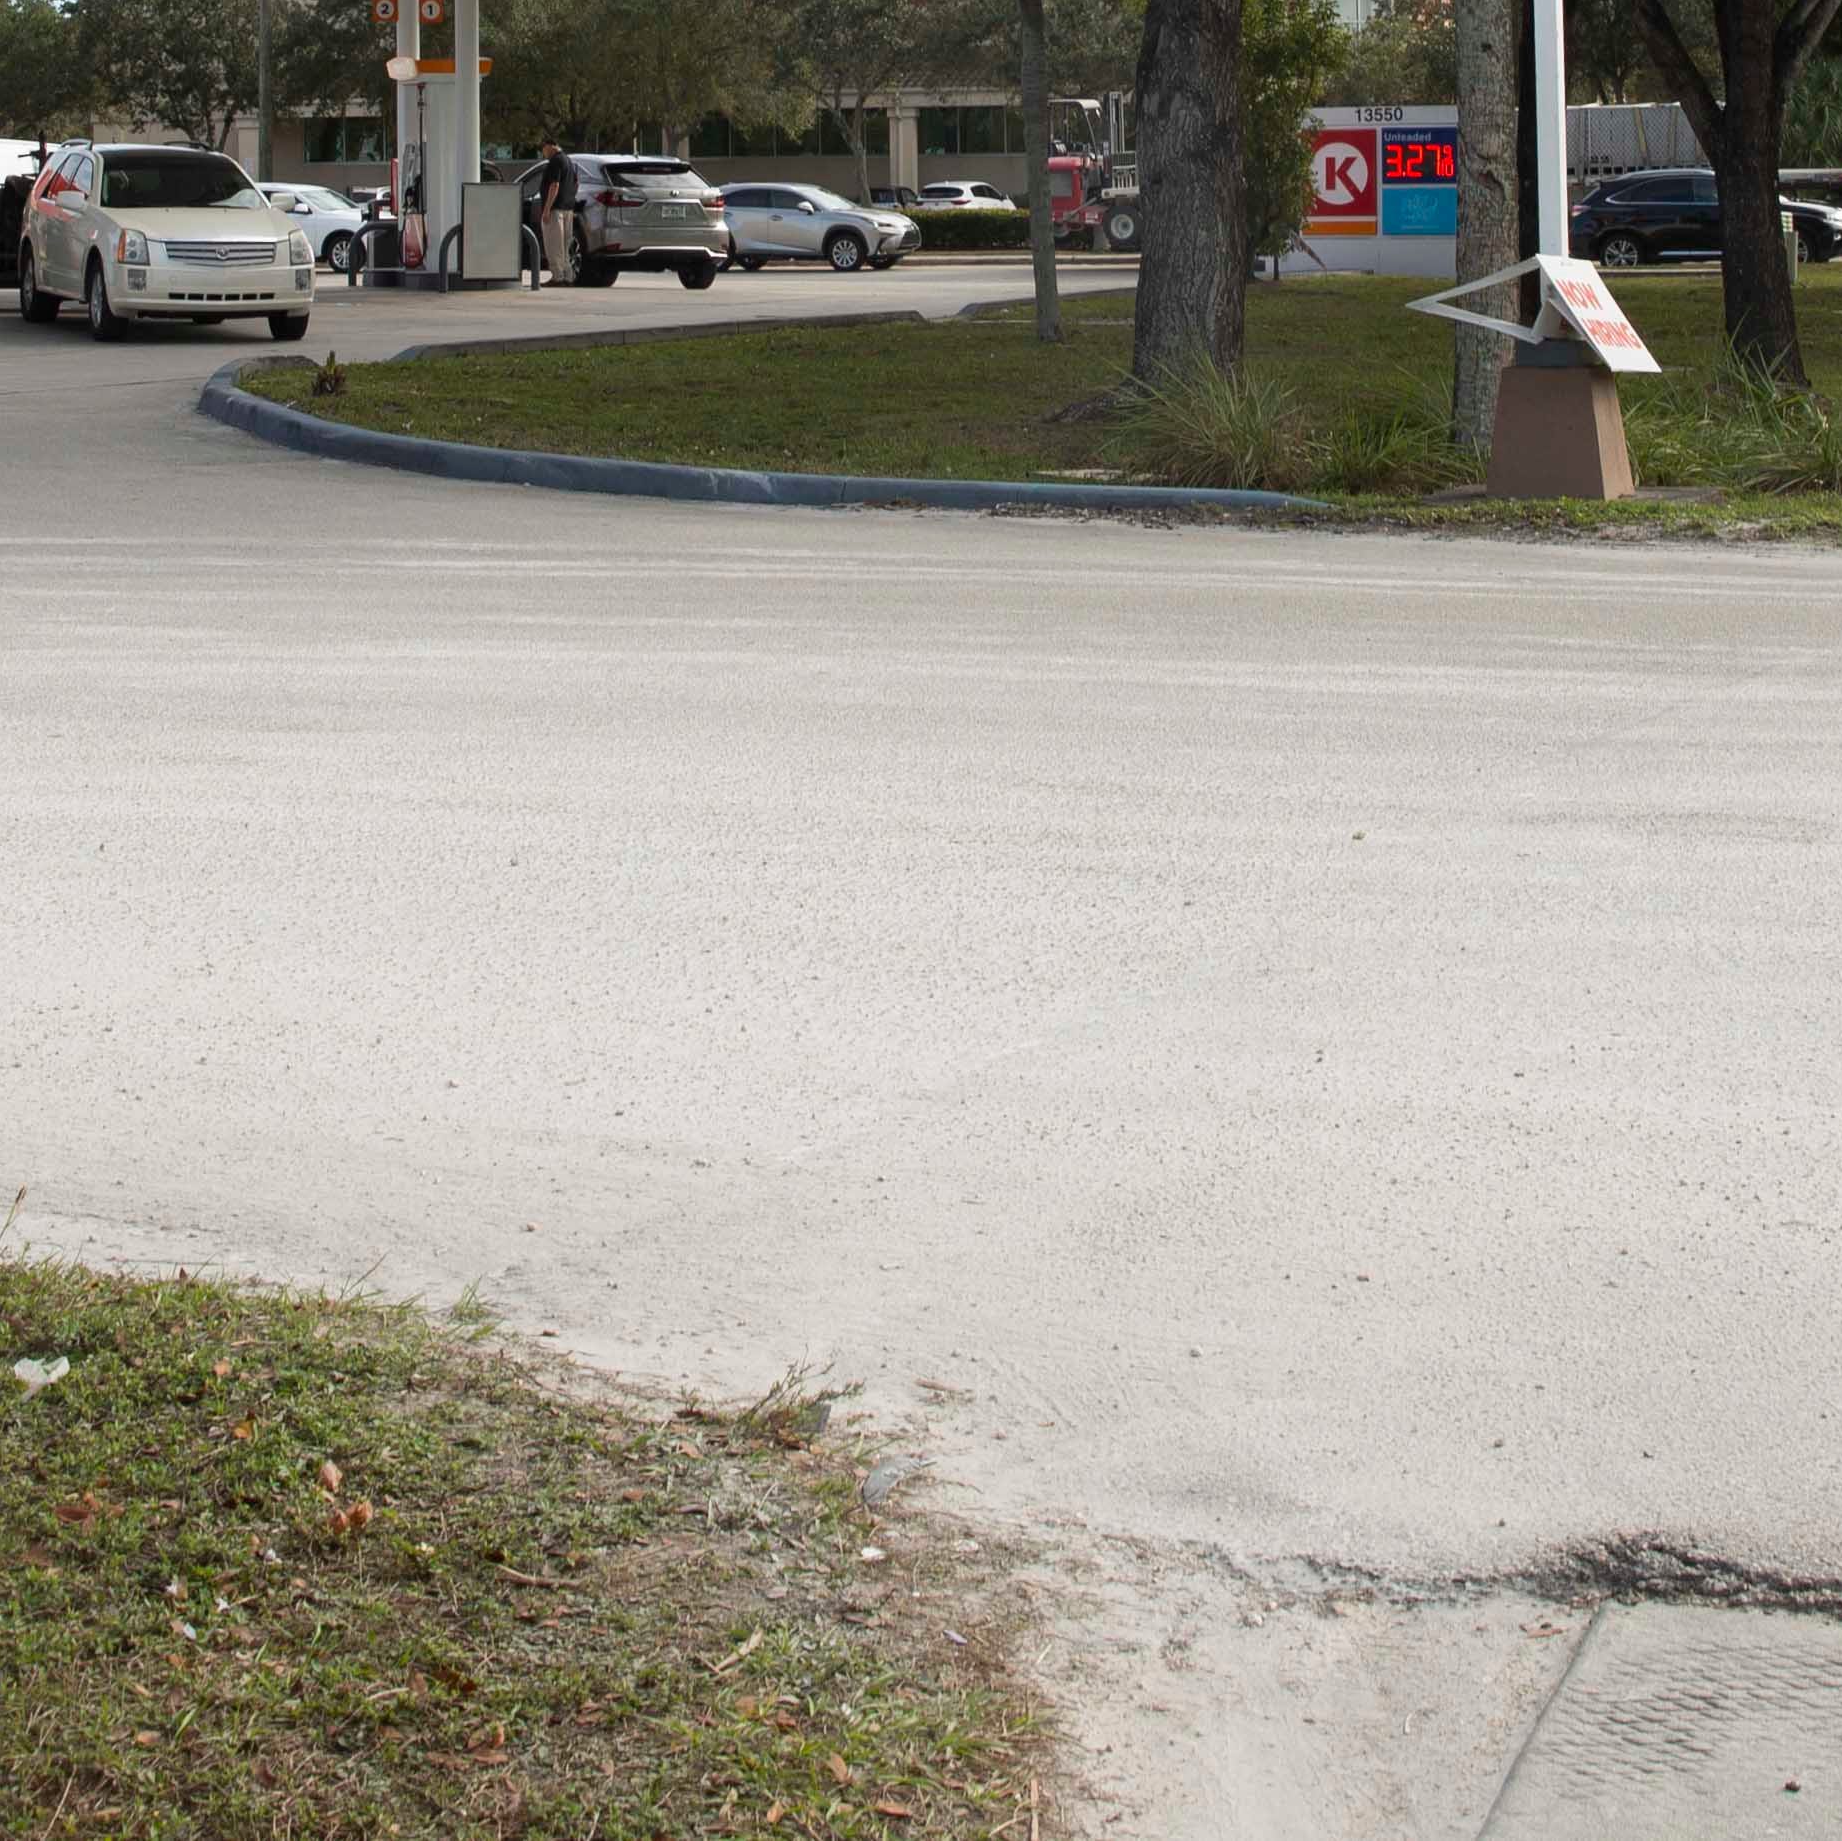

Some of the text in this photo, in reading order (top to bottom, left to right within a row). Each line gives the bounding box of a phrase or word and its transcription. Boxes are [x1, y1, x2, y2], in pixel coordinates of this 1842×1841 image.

[381, 3, 390, 15] 2
[426, 4, 434, 16] 1
[1355, 107, 1403, 122] 13550
[1384, 132, 1431, 143] Unleaded
[1325, 157, 1362, 200] K
[1556, 278, 1602, 311] NOW
[1582, 318, 1642, 350] HIRING
